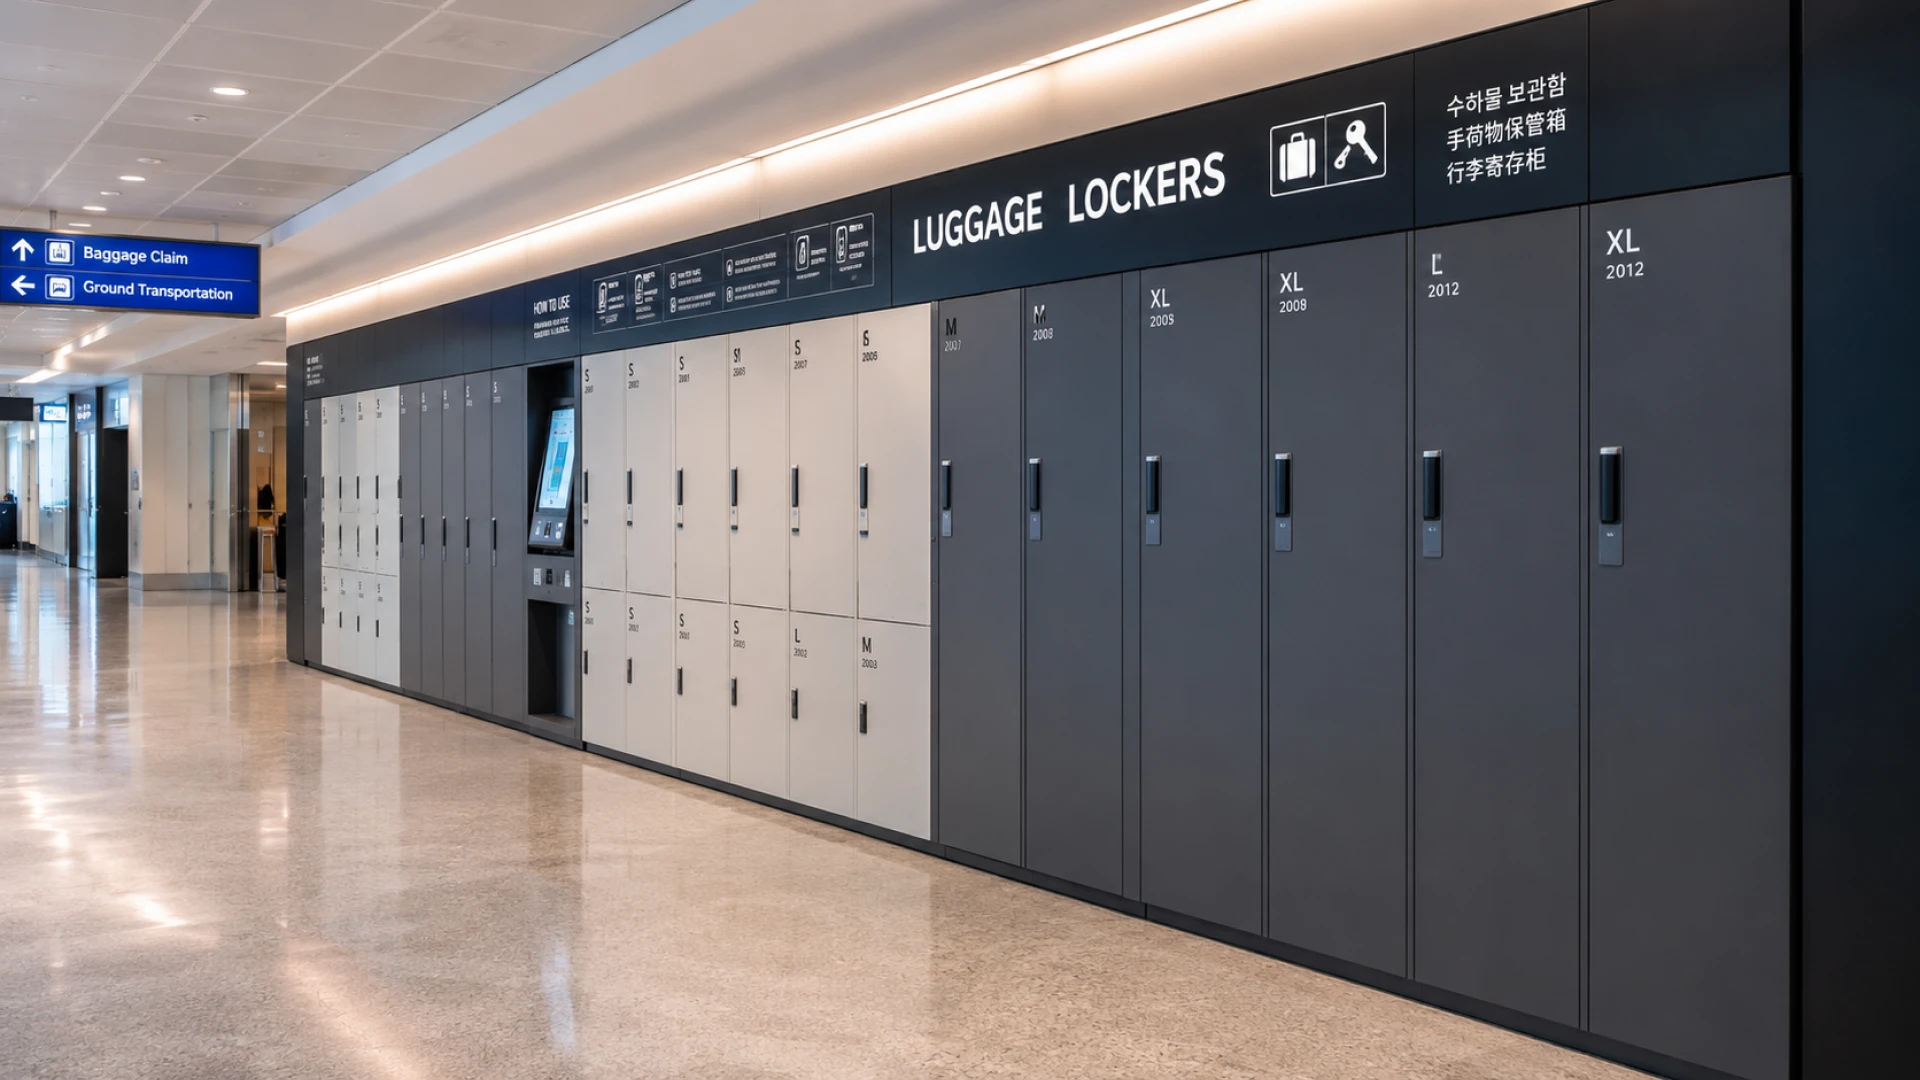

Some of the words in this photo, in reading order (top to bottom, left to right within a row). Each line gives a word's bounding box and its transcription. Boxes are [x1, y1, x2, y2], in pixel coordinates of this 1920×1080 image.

[1447, 87, 1503, 118] 수하물
[1507, 72, 1567, 104] 보관함
[1447, 107, 1567, 152] 手荷物保管箱
[1447, 147, 1547, 185] 行李寄存柜
[913, 190, 1043, 254] LUGGAGE
[1068, 151, 1226, 223] LOCKERS
[1606, 228, 1641, 256] XL
[84, 246, 147, 265] Baggage
[150, 249, 188, 265] Claim
[1606, 261, 1644, 280] 2012
[83, 280, 135, 295] Ground
[138, 284, 233, 301] Transportation
[1279, 271, 1304, 294] XL
[1428, 281, 1459, 298] 2012
[1150, 288, 1171, 309] XL
[1279, 298, 1307, 313] 2008
[946, 317, 957, 336] M
[795, 339, 801, 356] S
[629, 362, 634, 377] S
[680, 356, 684, 371] S
[585, 368, 590, 382] S
[585, 601, 590, 614] S
[629, 606, 635, 620] S
[680, 613, 685, 628] S
[734, 620, 740, 635] S
[795, 628, 801, 643] L
[862, 636, 872, 654] M
